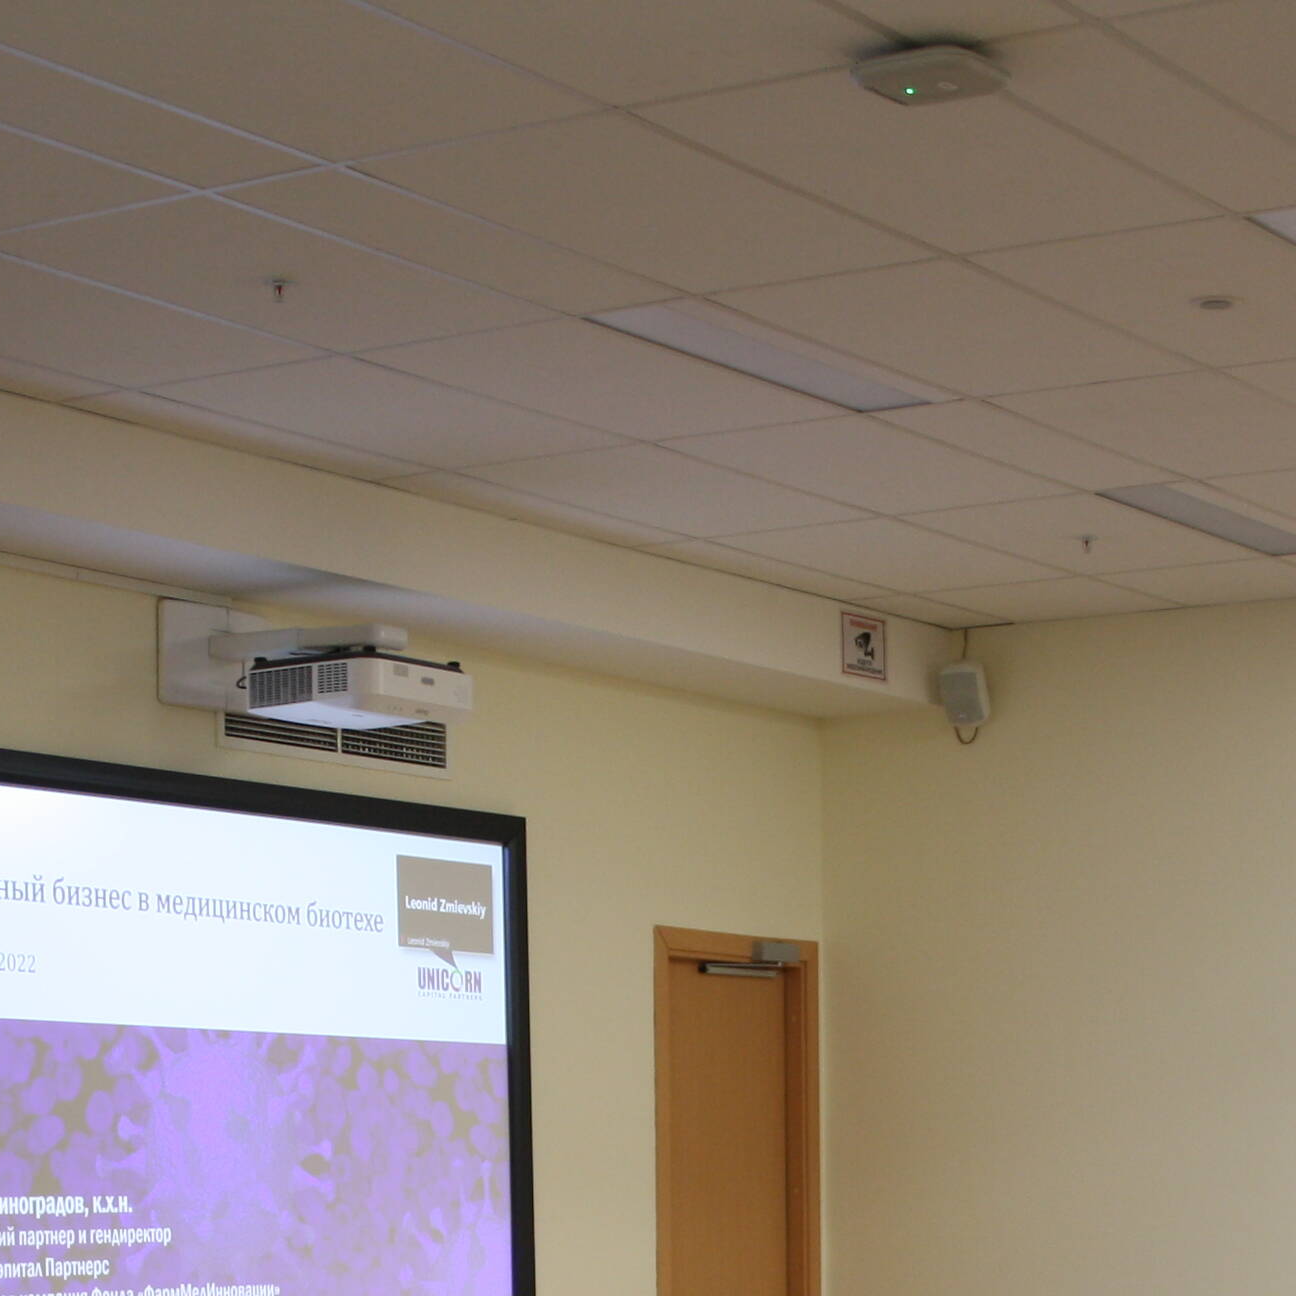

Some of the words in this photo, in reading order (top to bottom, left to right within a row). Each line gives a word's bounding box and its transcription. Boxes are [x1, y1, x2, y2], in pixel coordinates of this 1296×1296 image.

[53, 877, 132, 911] бизнес
[138, 891, 149, 912] в
[156, 893, 302, 925] медицинском
[306, 901, 384, 933] биотехе
[405, 895, 438, 912] Leonid
[439, 899, 486, 920] Zmievskiy
[417, 966, 482, 993] UNICORN
[93, 1195, 133, 1214] к.х.н.
[18, 1229, 75, 1249] партнер
[78, 1230, 87, 1245] и
[89, 1227, 172, 1247] гендиректор
[45, 1257, 110, 1280] Партнерс
